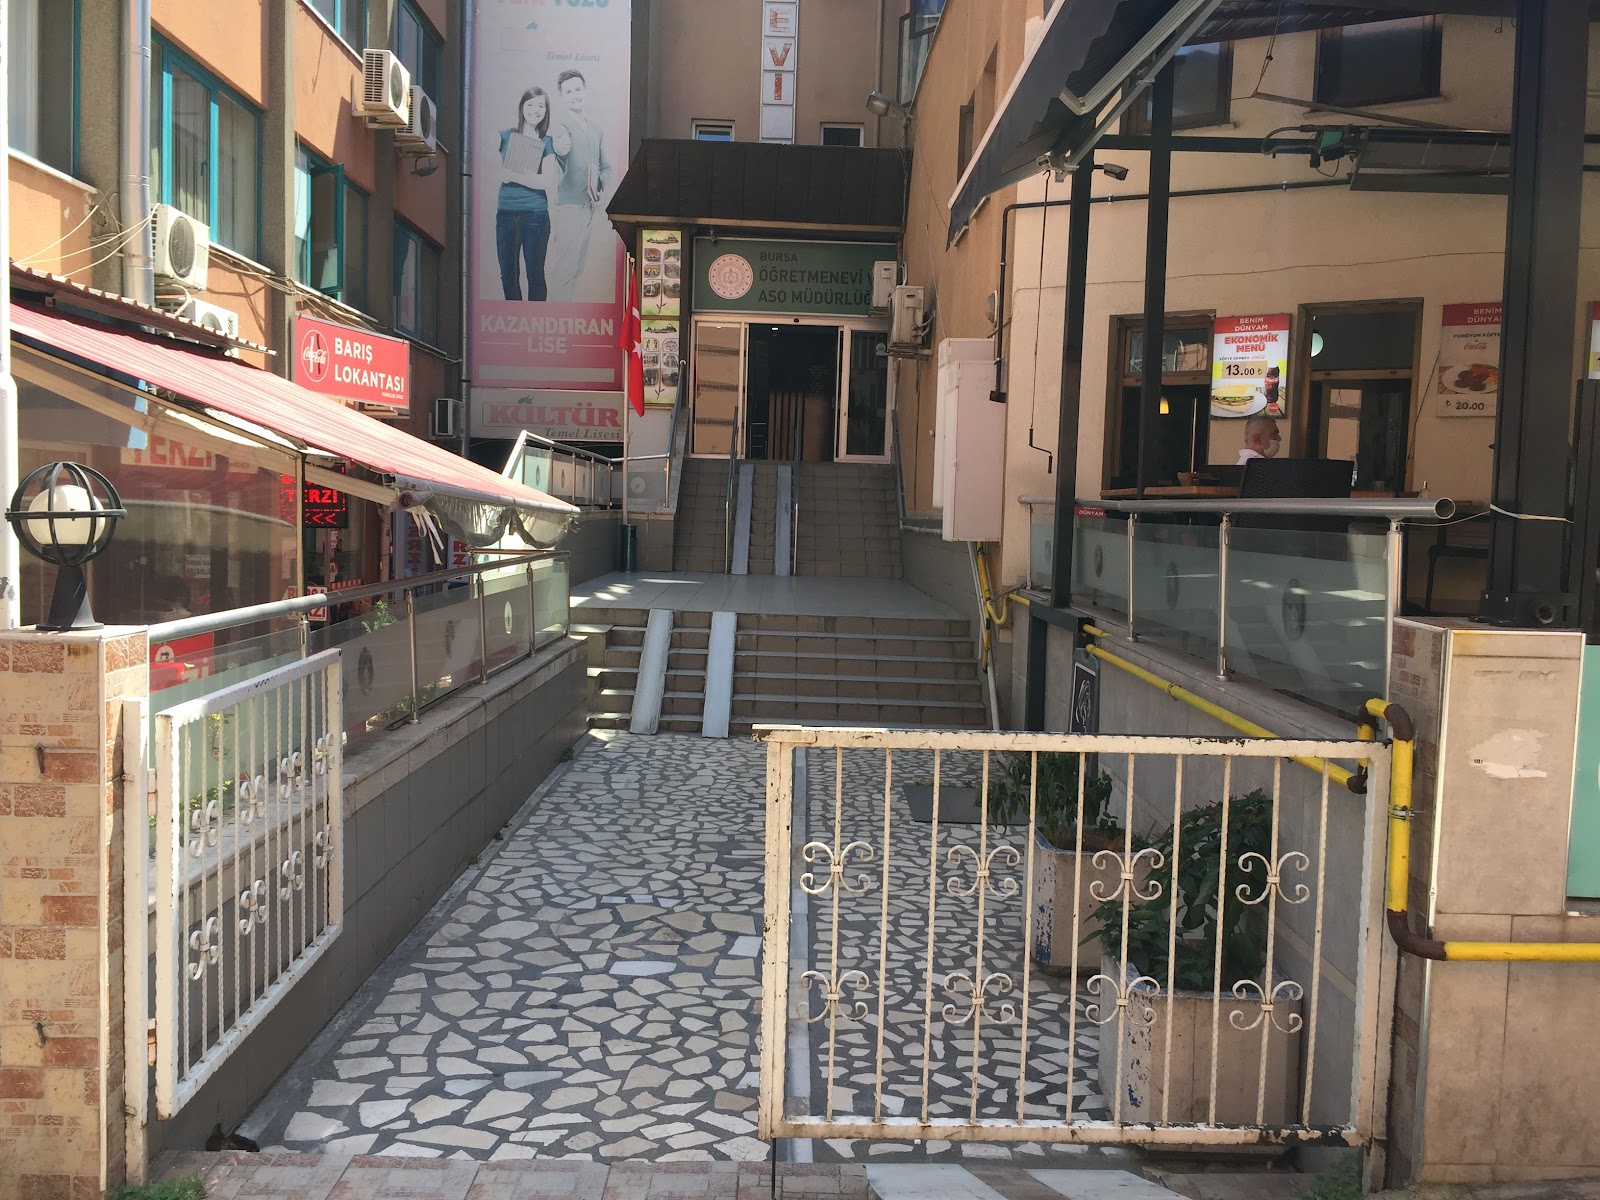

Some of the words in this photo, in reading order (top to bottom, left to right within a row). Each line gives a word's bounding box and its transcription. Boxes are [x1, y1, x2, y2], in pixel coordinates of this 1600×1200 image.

[760, 251, 798, 262] BURSA
[759, 267, 863, 285] ÖĞRETMENEVİ
[758, 290, 787, 303] ASO
[791, 287, 872, 306] MÜDÜRLÜĞ
[1234, 324, 1268, 332] DÜNYAM
[334, 337, 373, 364] BARIŞ
[1236, 342, 1266, 353] MENÜ
[1225, 364, 1255, 376] 13.00
[334, 363, 404, 393] LOKANTASI
[1455, 401, 1485, 411] 20.00
[544, 427, 580, 438] Temel
[583, 429, 621, 439] Lisesi
